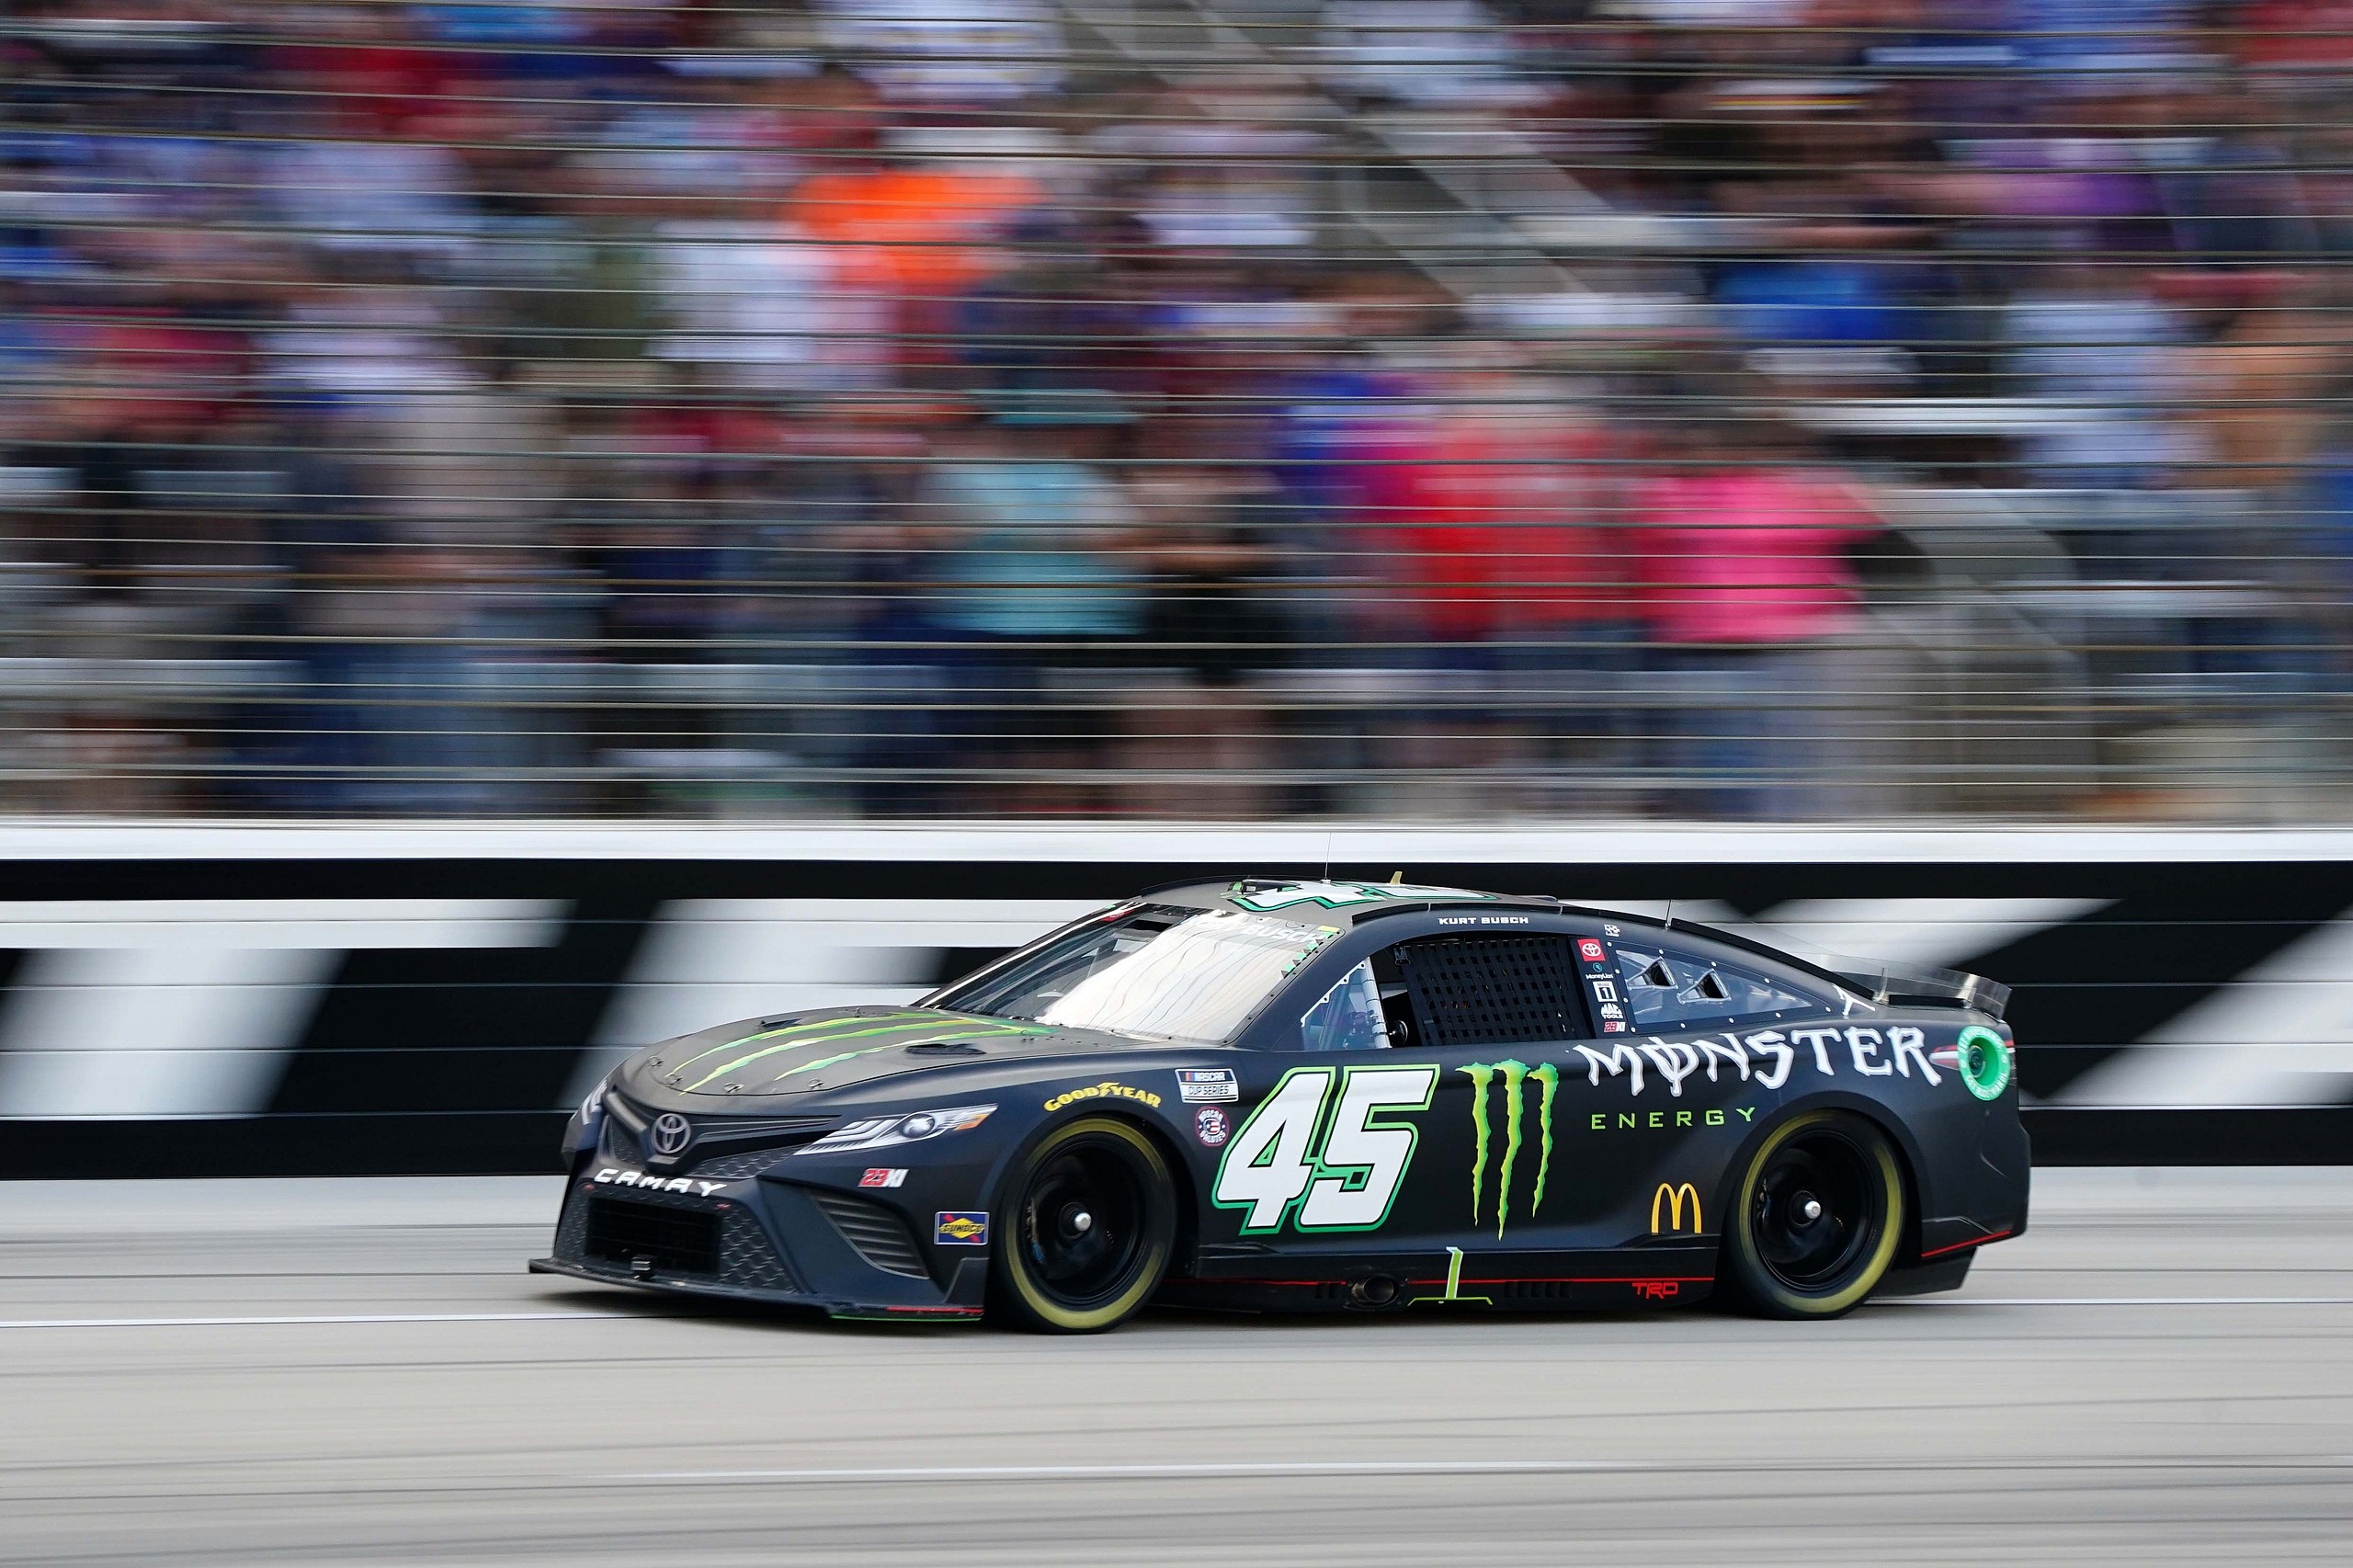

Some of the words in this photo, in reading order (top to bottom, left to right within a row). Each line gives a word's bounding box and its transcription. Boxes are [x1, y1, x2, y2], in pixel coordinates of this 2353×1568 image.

[1573, 1026, 1942, 1097] MONSTER
[1193, 1072, 1225, 1082] NASCAR
[1043, 1082, 1162, 1112] GOODYEAR
[1188, 1086, 1202, 1095] CUP
[1203, 1085, 1229, 1095] SERIES
[1590, 1107, 1756, 1131] ENERGY
[1211, 1064, 1440, 1236] 45
[941, 1223, 983, 1233] SUNOCO
[1631, 1281, 1679, 1300] TRD
